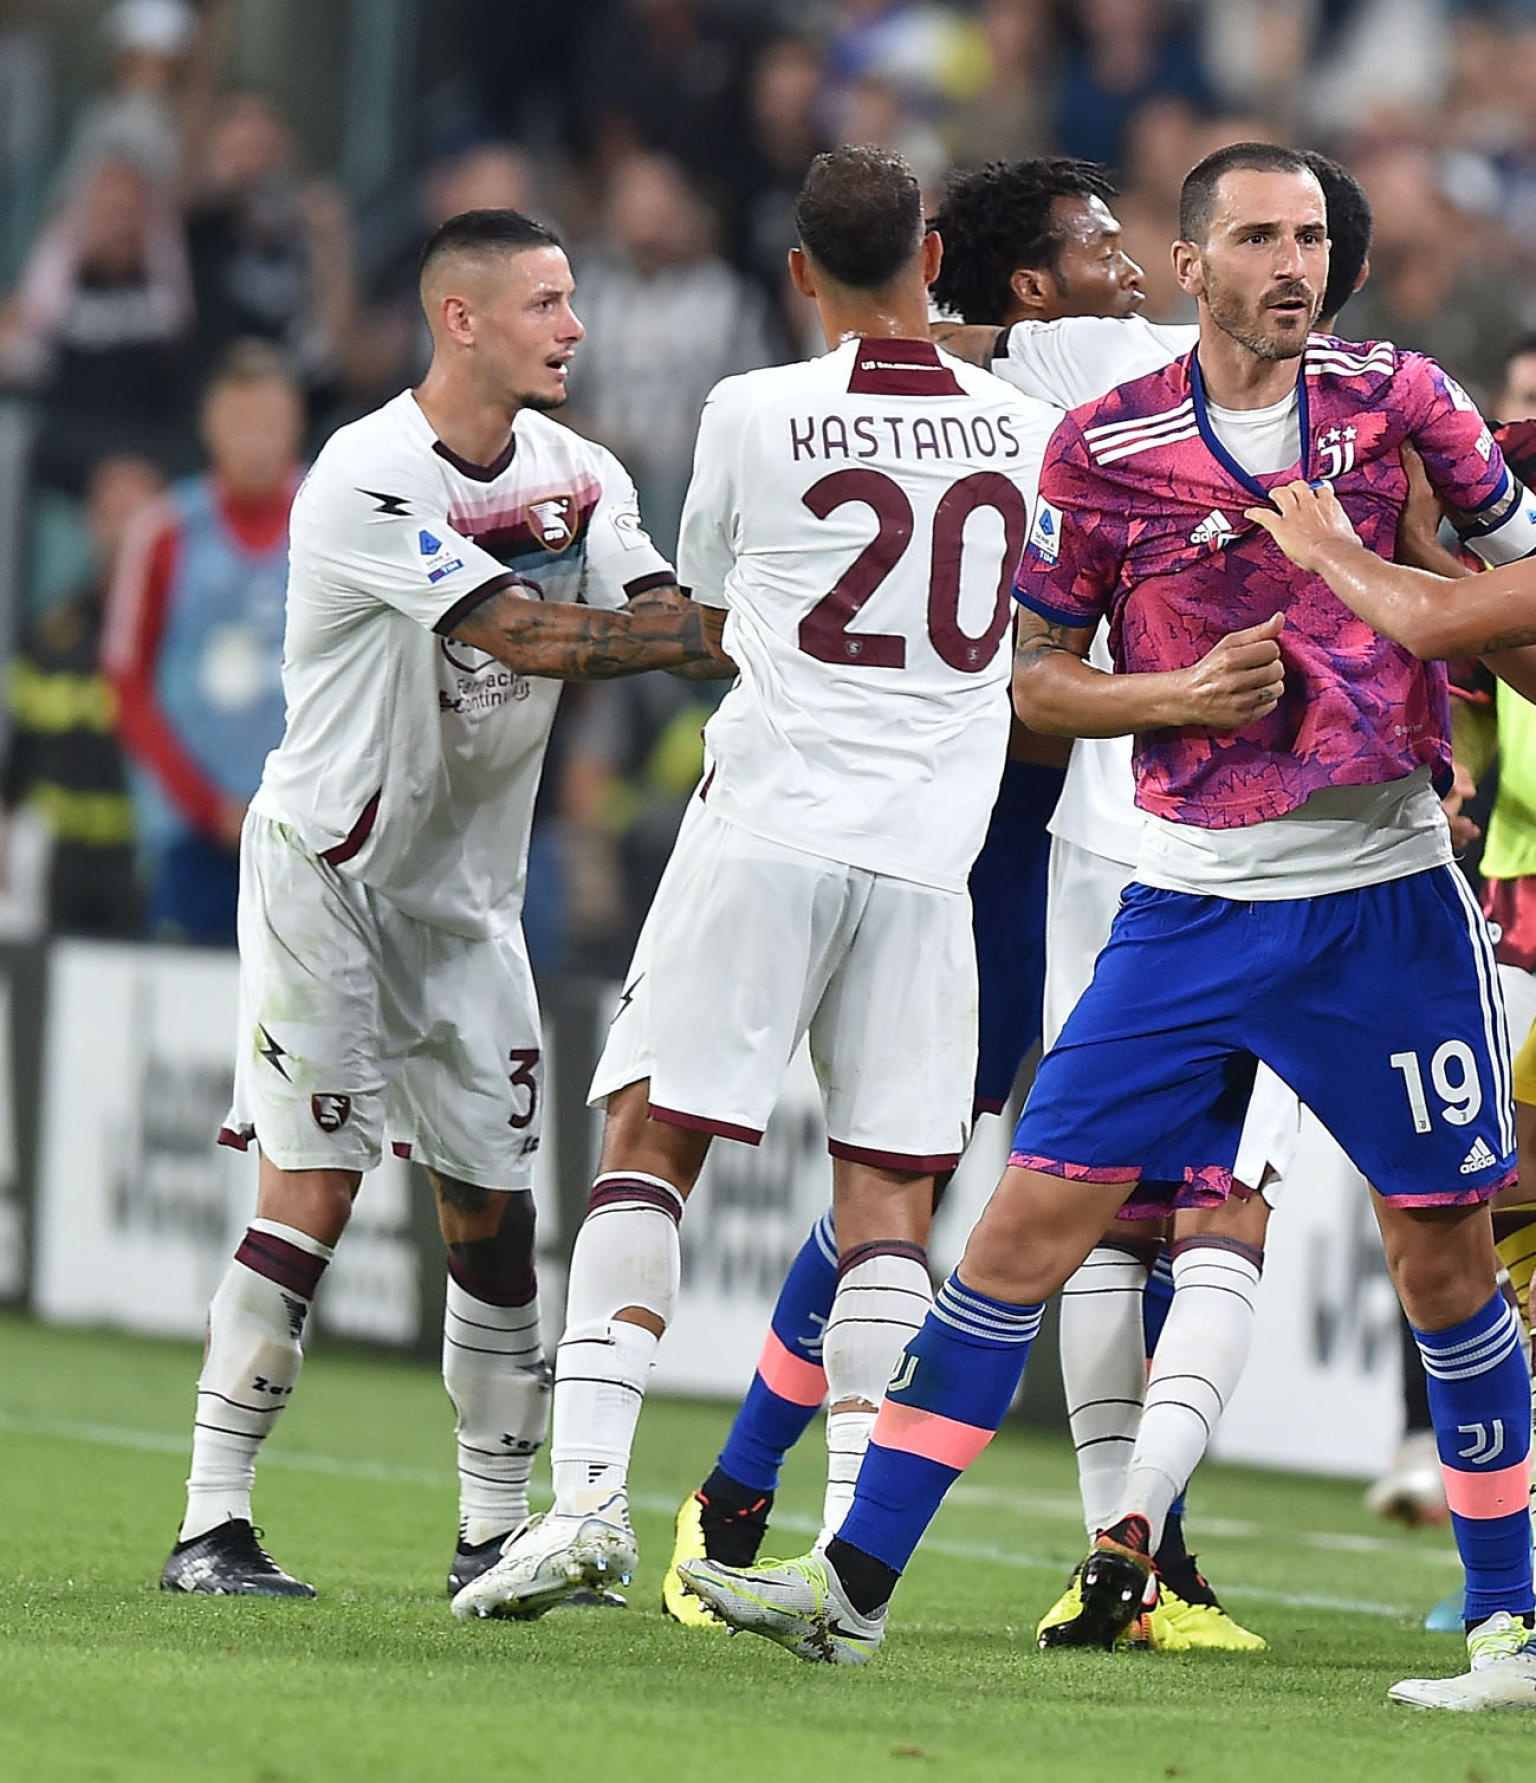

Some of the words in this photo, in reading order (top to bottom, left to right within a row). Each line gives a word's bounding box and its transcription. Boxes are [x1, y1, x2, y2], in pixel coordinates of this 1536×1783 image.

[789, 415, 1020, 461] KASTANOS
[798, 467, 1027, 673] 20
[507, 1048, 540, 1129] 3
[1389, 1039, 1483, 1134] 19
[1459, 1153, 1497, 1175] adidas
